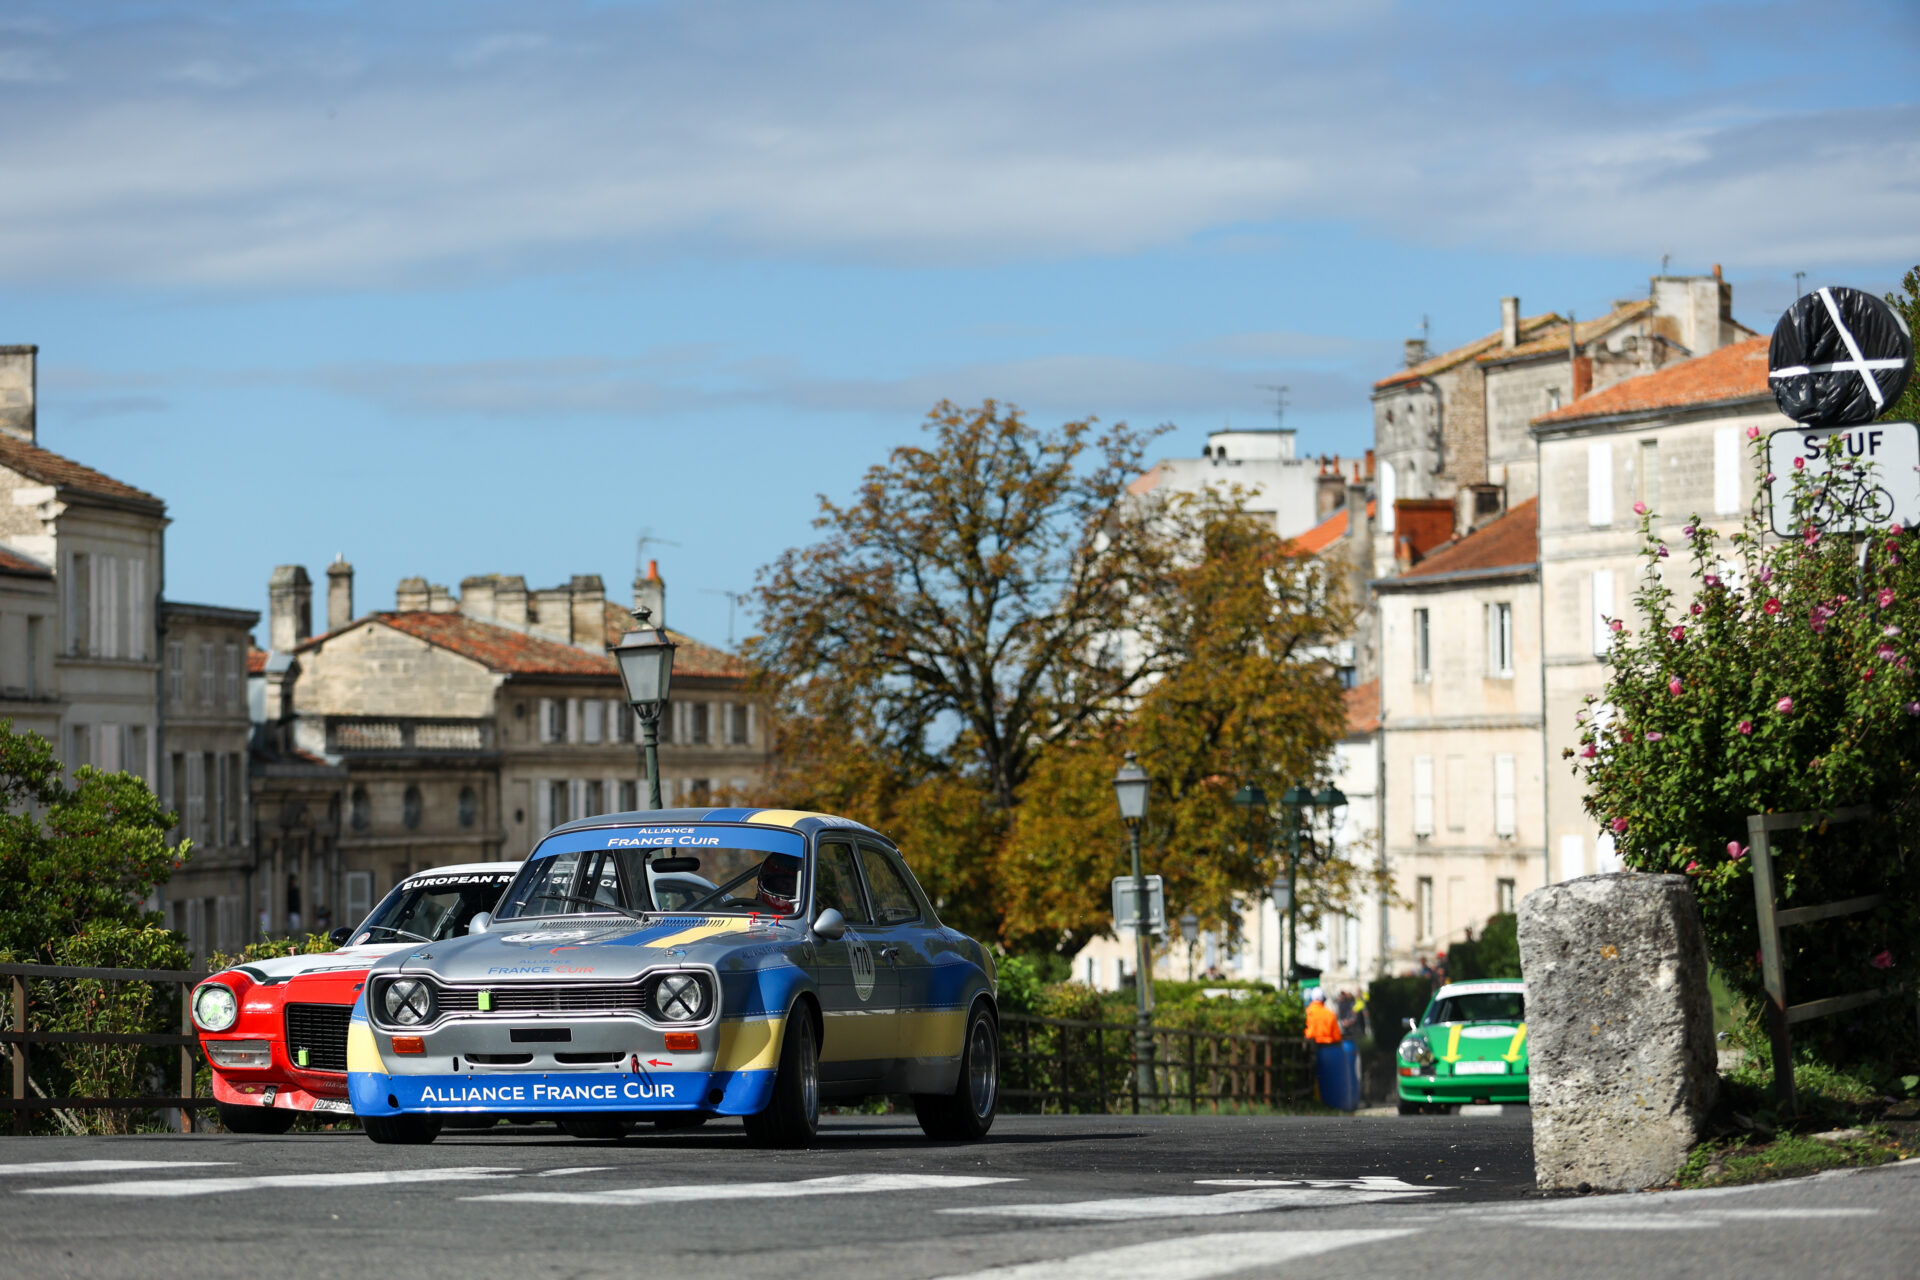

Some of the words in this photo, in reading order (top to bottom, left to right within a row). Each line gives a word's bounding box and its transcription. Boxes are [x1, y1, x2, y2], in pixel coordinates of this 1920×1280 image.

[607, 837, 675, 847] FRANCE
[678, 836, 720, 845] CUIR
[402, 875, 493, 891] EUROPEAN
[853, 946, 871, 975] 170
[488, 966, 552, 974] FRANCE
[555, 965, 595, 974] CUIR
[420, 1085, 525, 1102] ALLIANCE
[533, 1084, 618, 1100] FRANCE
[623, 1082, 675, 1098] CUIR
